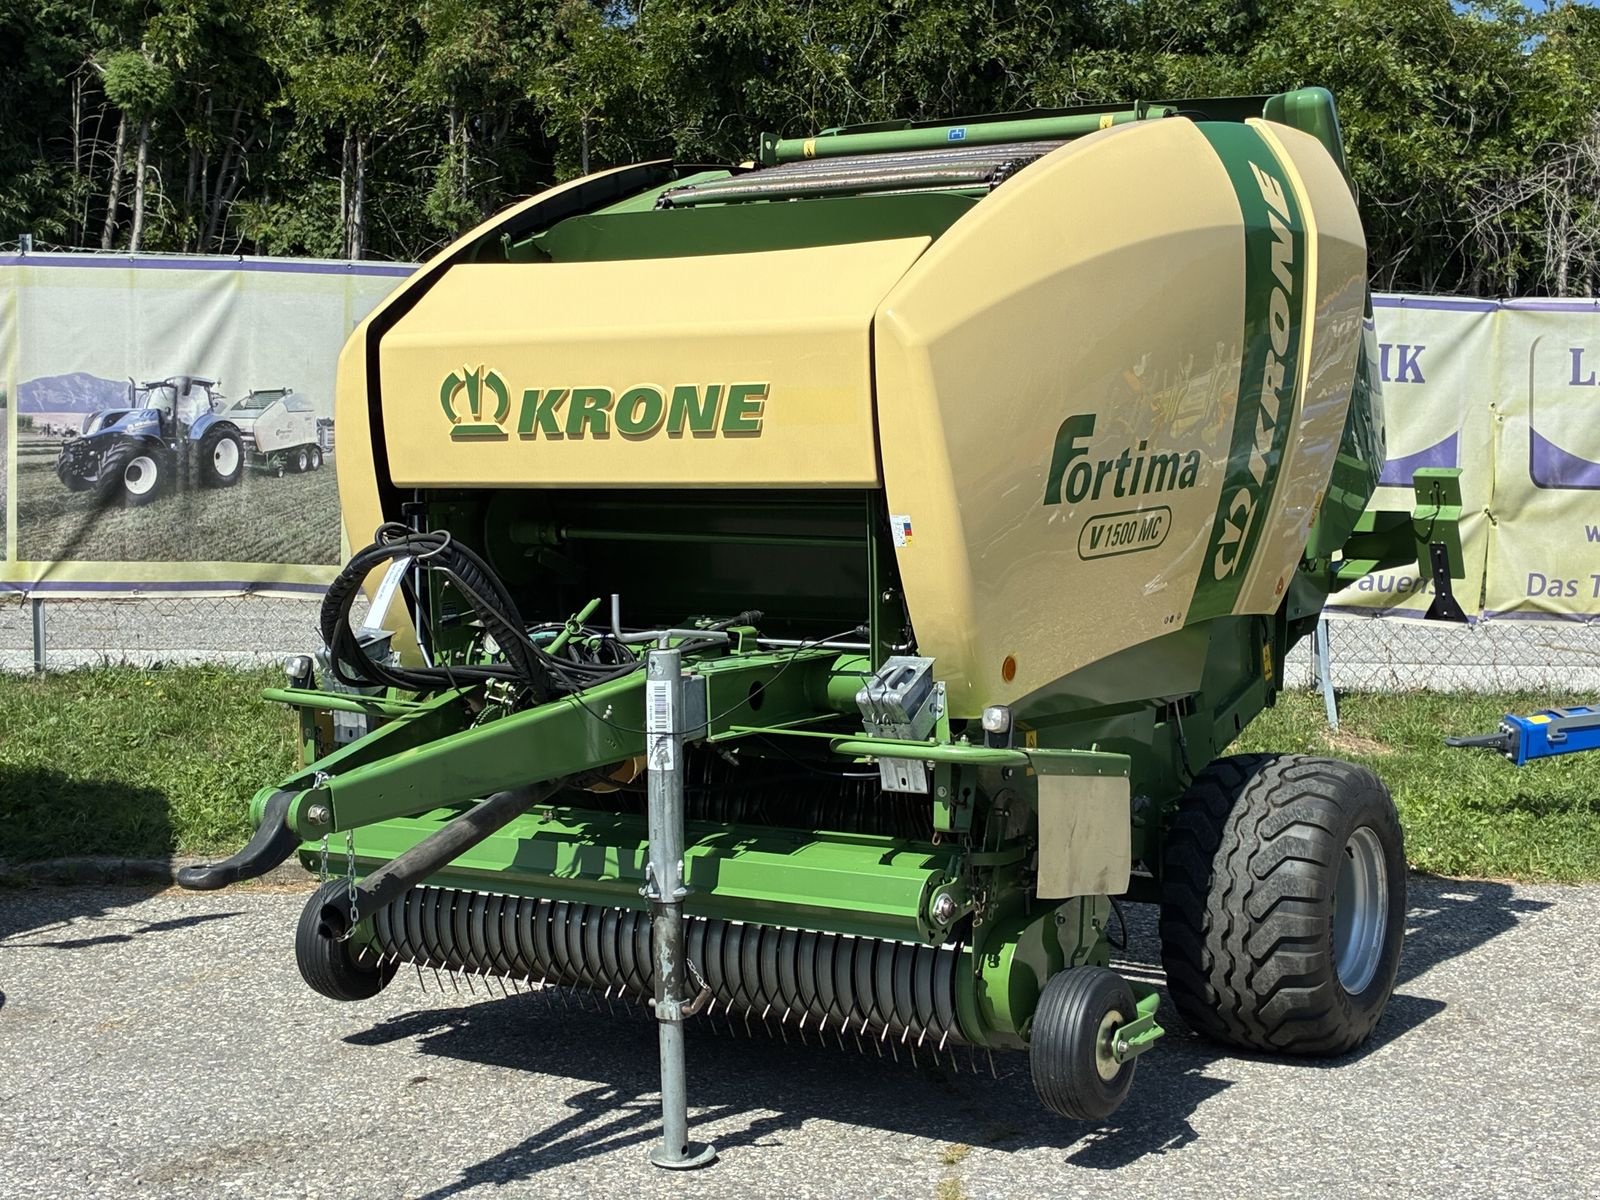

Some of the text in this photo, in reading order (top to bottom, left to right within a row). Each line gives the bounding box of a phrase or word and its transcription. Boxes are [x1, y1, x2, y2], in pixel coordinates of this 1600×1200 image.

[1248, 161, 1293, 488] KRONE
[1378, 343, 1426, 384] IK
[1568, 347, 1600, 386] L
[517, 383, 769, 438] KRONE
[1043, 413, 1201, 506] Fortima
[1089, 516, 1163, 550] V 1500 MC
[1526, 572, 1579, 598] Das
